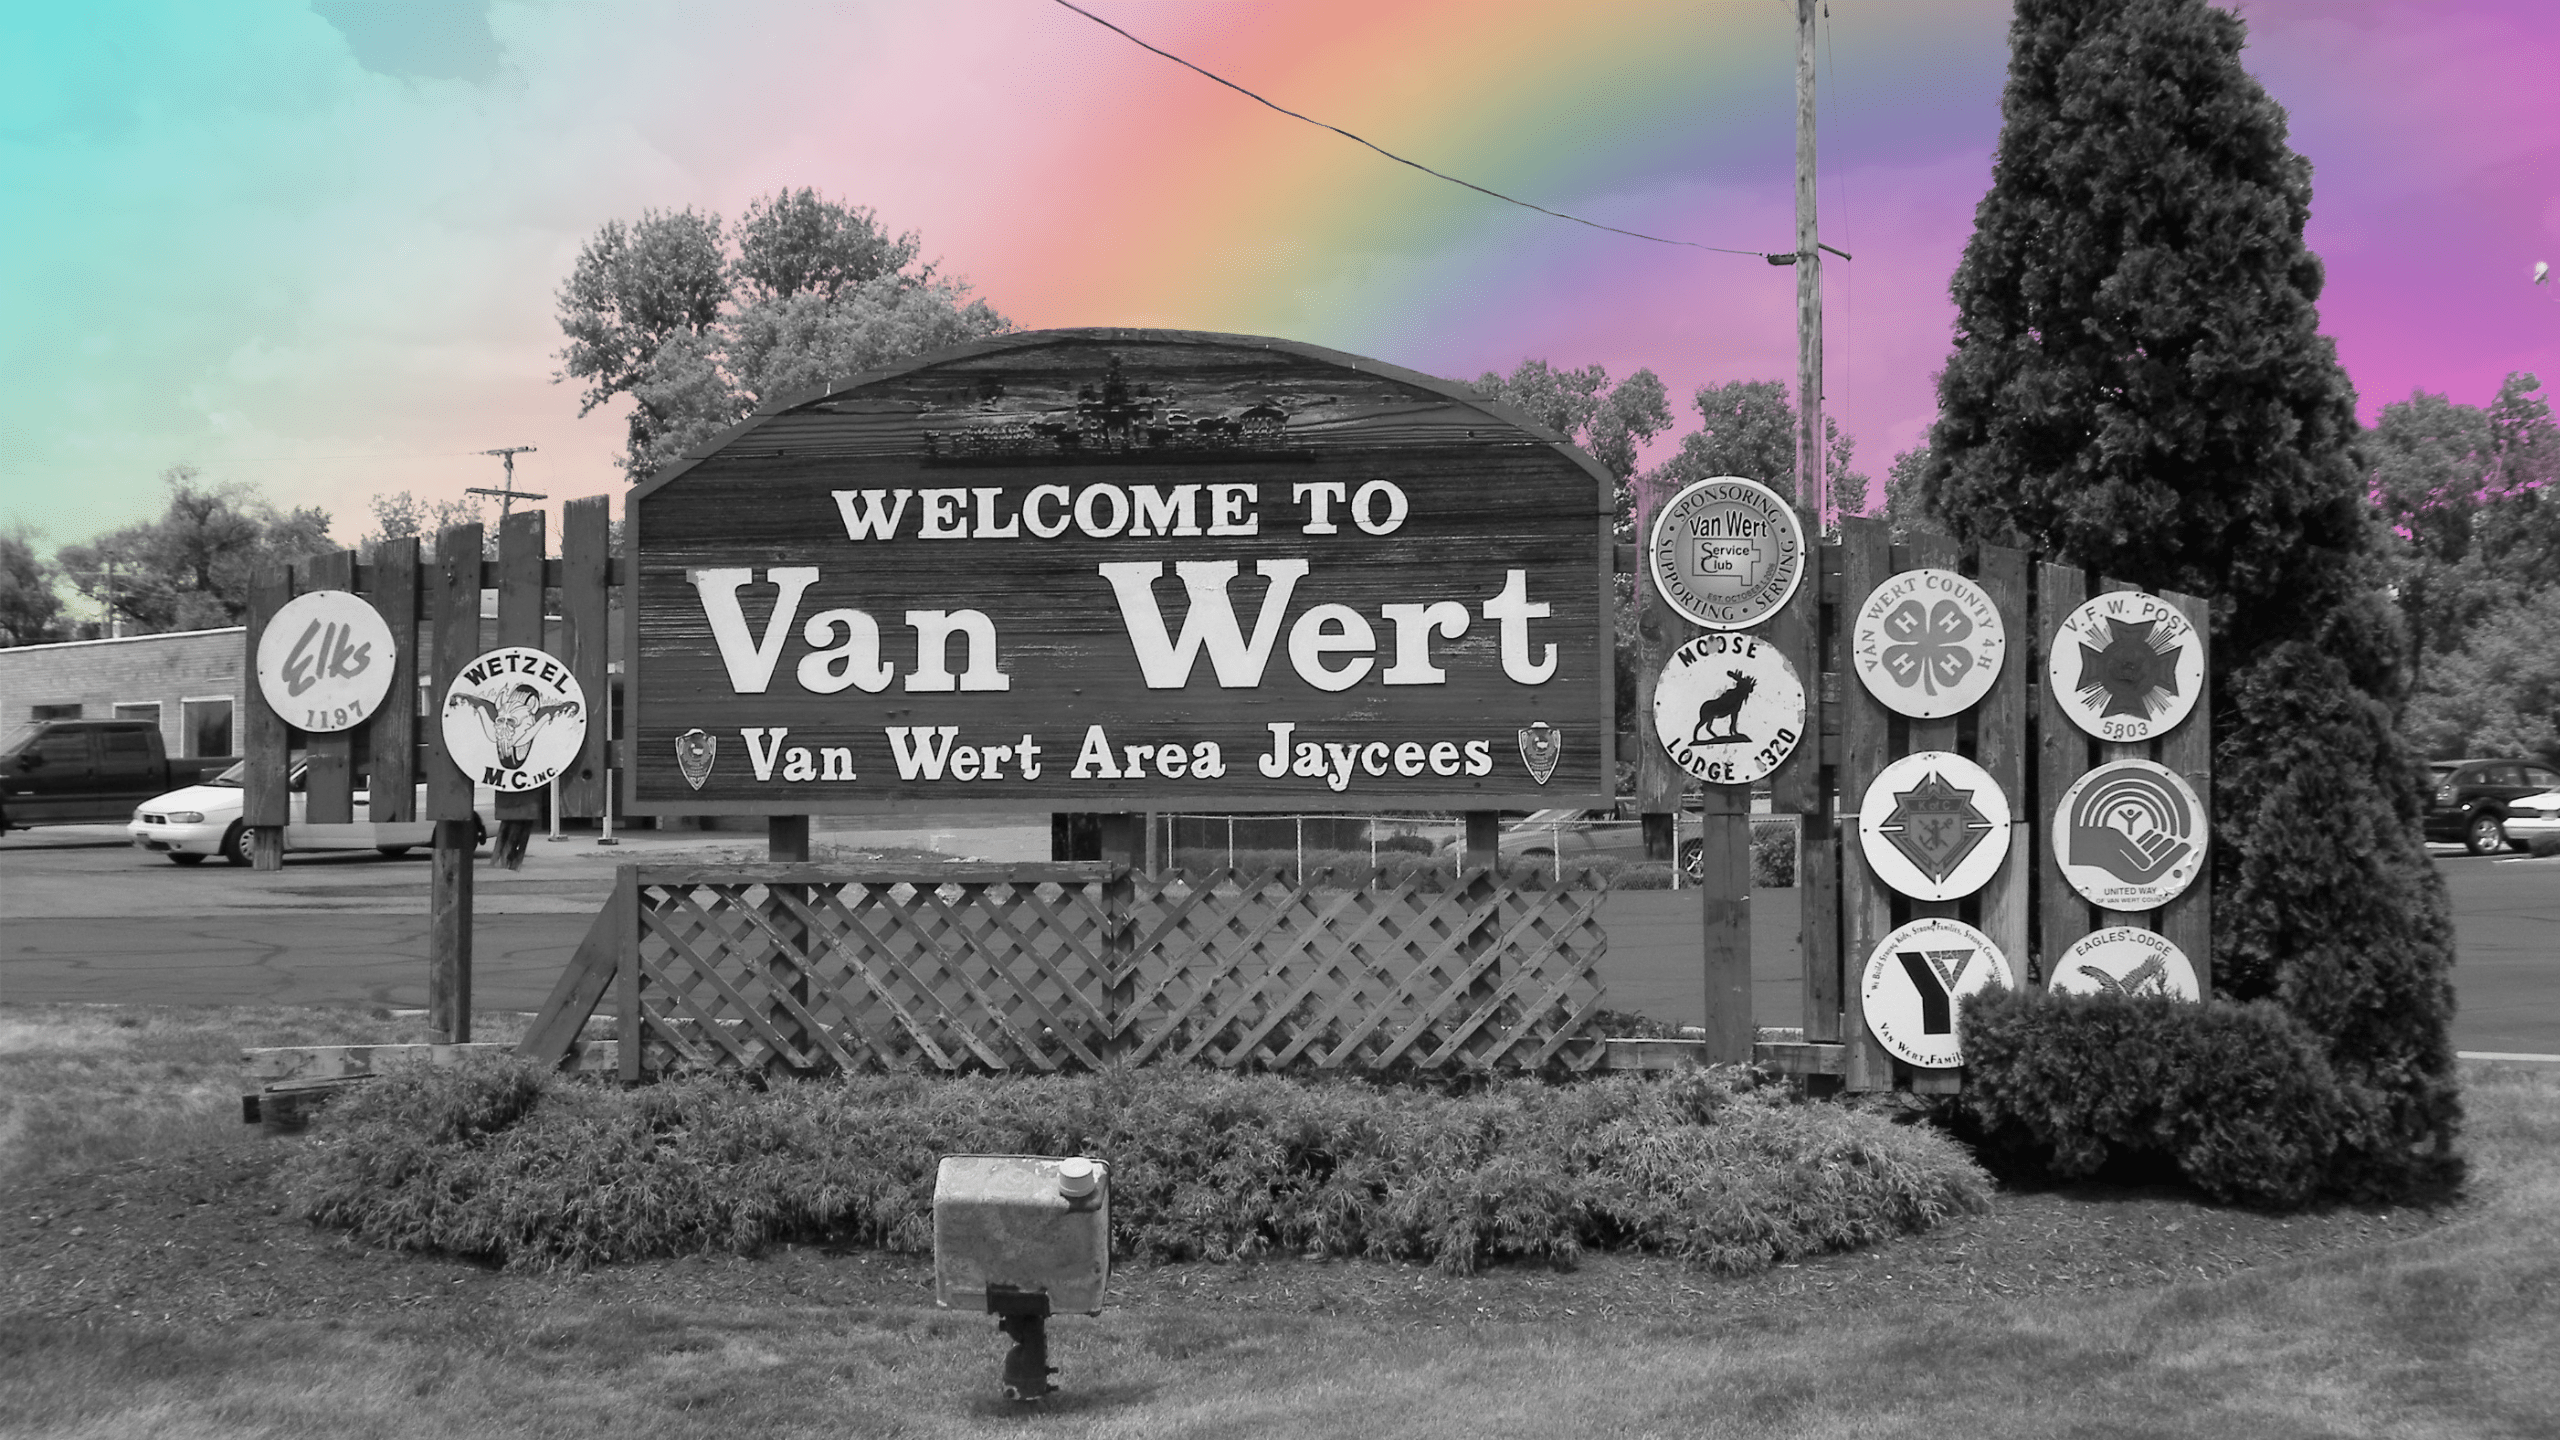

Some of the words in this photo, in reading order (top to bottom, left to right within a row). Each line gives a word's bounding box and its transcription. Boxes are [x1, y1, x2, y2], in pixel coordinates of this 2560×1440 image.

[832, 482, 1259, 541] WELCOME
[1293, 479, 1409, 537] TO
[1673, 485, 1783, 524] SPONSORING
[1689, 515, 1721, 537] Van
[1725, 510, 1768, 538] Wert
[1701, 542, 1750, 560] Service
[1701, 556, 1733, 573] Club
[1659, 537, 1734, 621] SUPPORTING
[1725, 584, 1761, 602] OCTOBER
[1755, 540, 1795, 610] SERVING
[1867, 577, 1916, 620] WERT
[1926, 575, 1994, 631] COUNTY
[686, 566, 1010, 694] Van
[1098, 558, 1558, 690] Wert
[1894, 610, 1919, 634] H
[1938, 610, 1962, 634] H
[2064, 599, 2131, 633] V.F.W.
[2142, 602, 2192, 637] POST
[281, 617, 372, 698] Elks
[1677, 635, 1757, 668] MOOSE
[1862, 629, 1878, 673] VAN
[1892, 652, 1916, 676] H
[1939, 653, 1963, 676] H
[1976, 638, 1996, 670] 4-H
[464, 653, 569, 695] WETZEL
[2102, 720, 2148, 738] 5803
[740, 725, 856, 783] Van
[885, 723, 1042, 782] Wert
[1070, 723, 1227, 780] Area
[1258, 721, 1492, 793] Jaycees
[1666, 737, 1735, 781] LODGE
[2104, 887, 2137, 896] UNITED
[2138, 886, 2157, 895] WAY
[2075, 931, 2125, 957] EAGLES
[2129, 933, 2173, 957] LODGE
